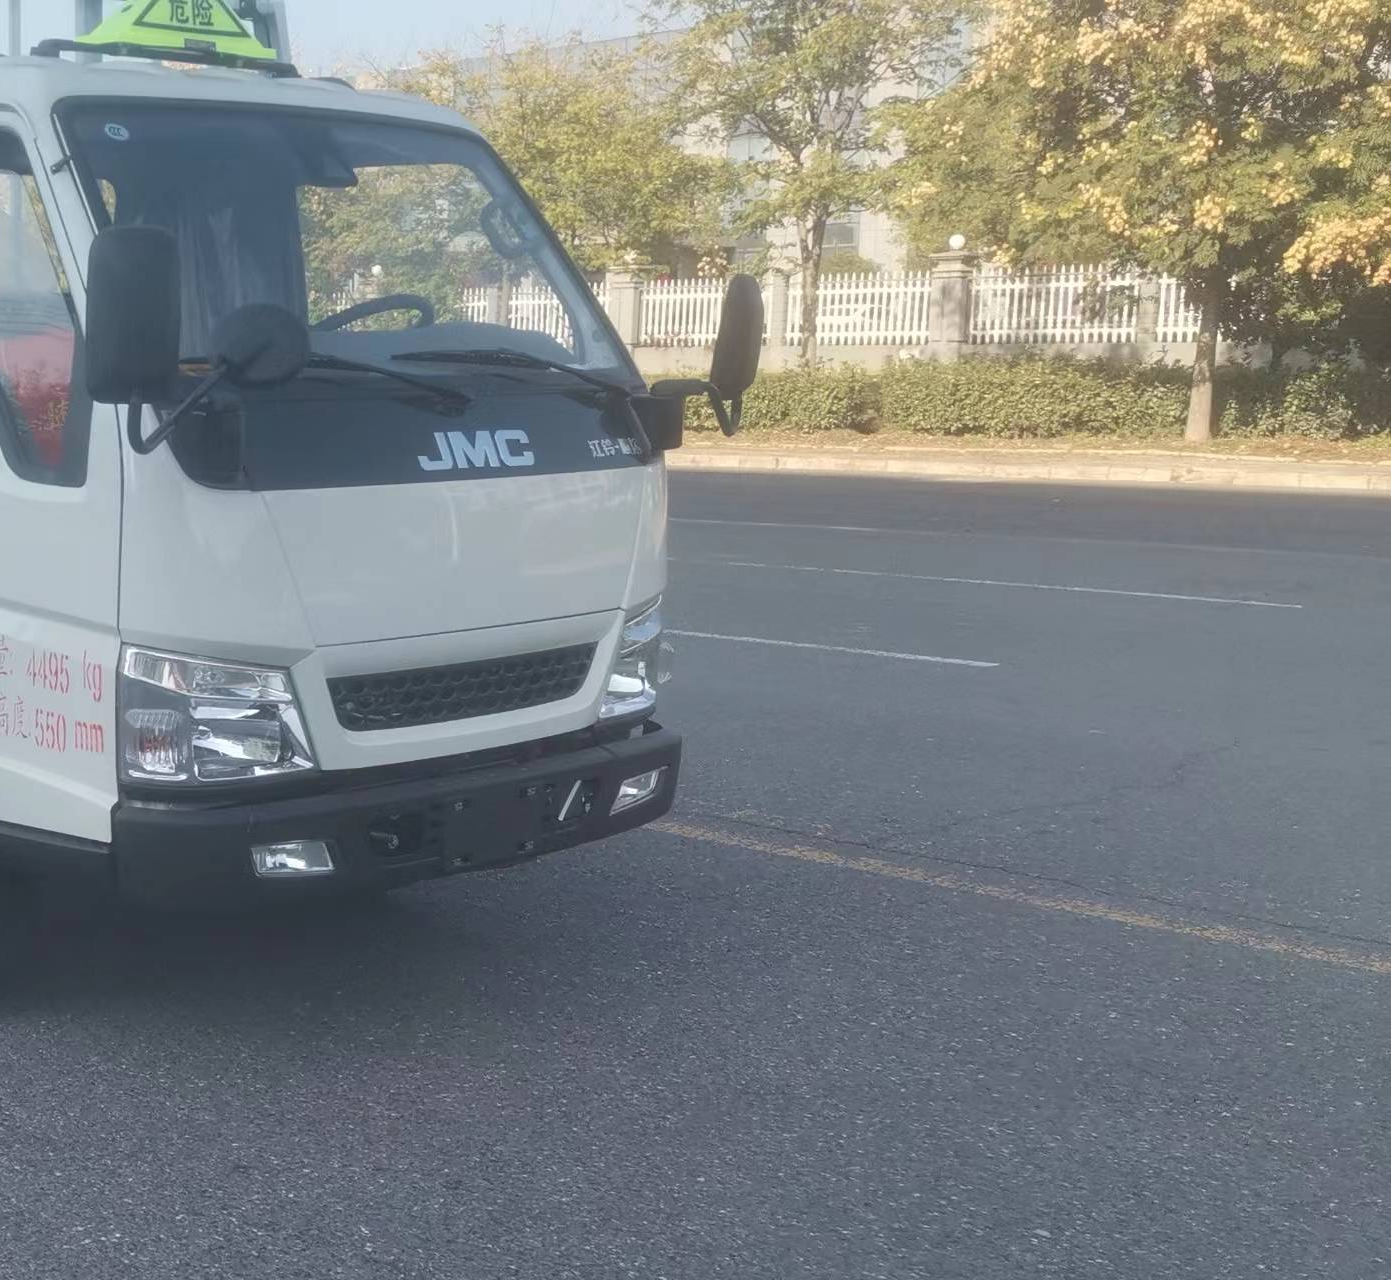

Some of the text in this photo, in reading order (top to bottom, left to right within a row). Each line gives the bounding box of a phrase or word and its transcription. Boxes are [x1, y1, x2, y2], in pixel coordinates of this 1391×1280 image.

[169, 0, 214, 26] 危险
[417, 429, 535, 471] JMC
[26, 648, 70, 694] 4495
[81, 649, 103, 703] kg
[34, 707, 67, 753] 550
[74, 719, 104, 753] mm
